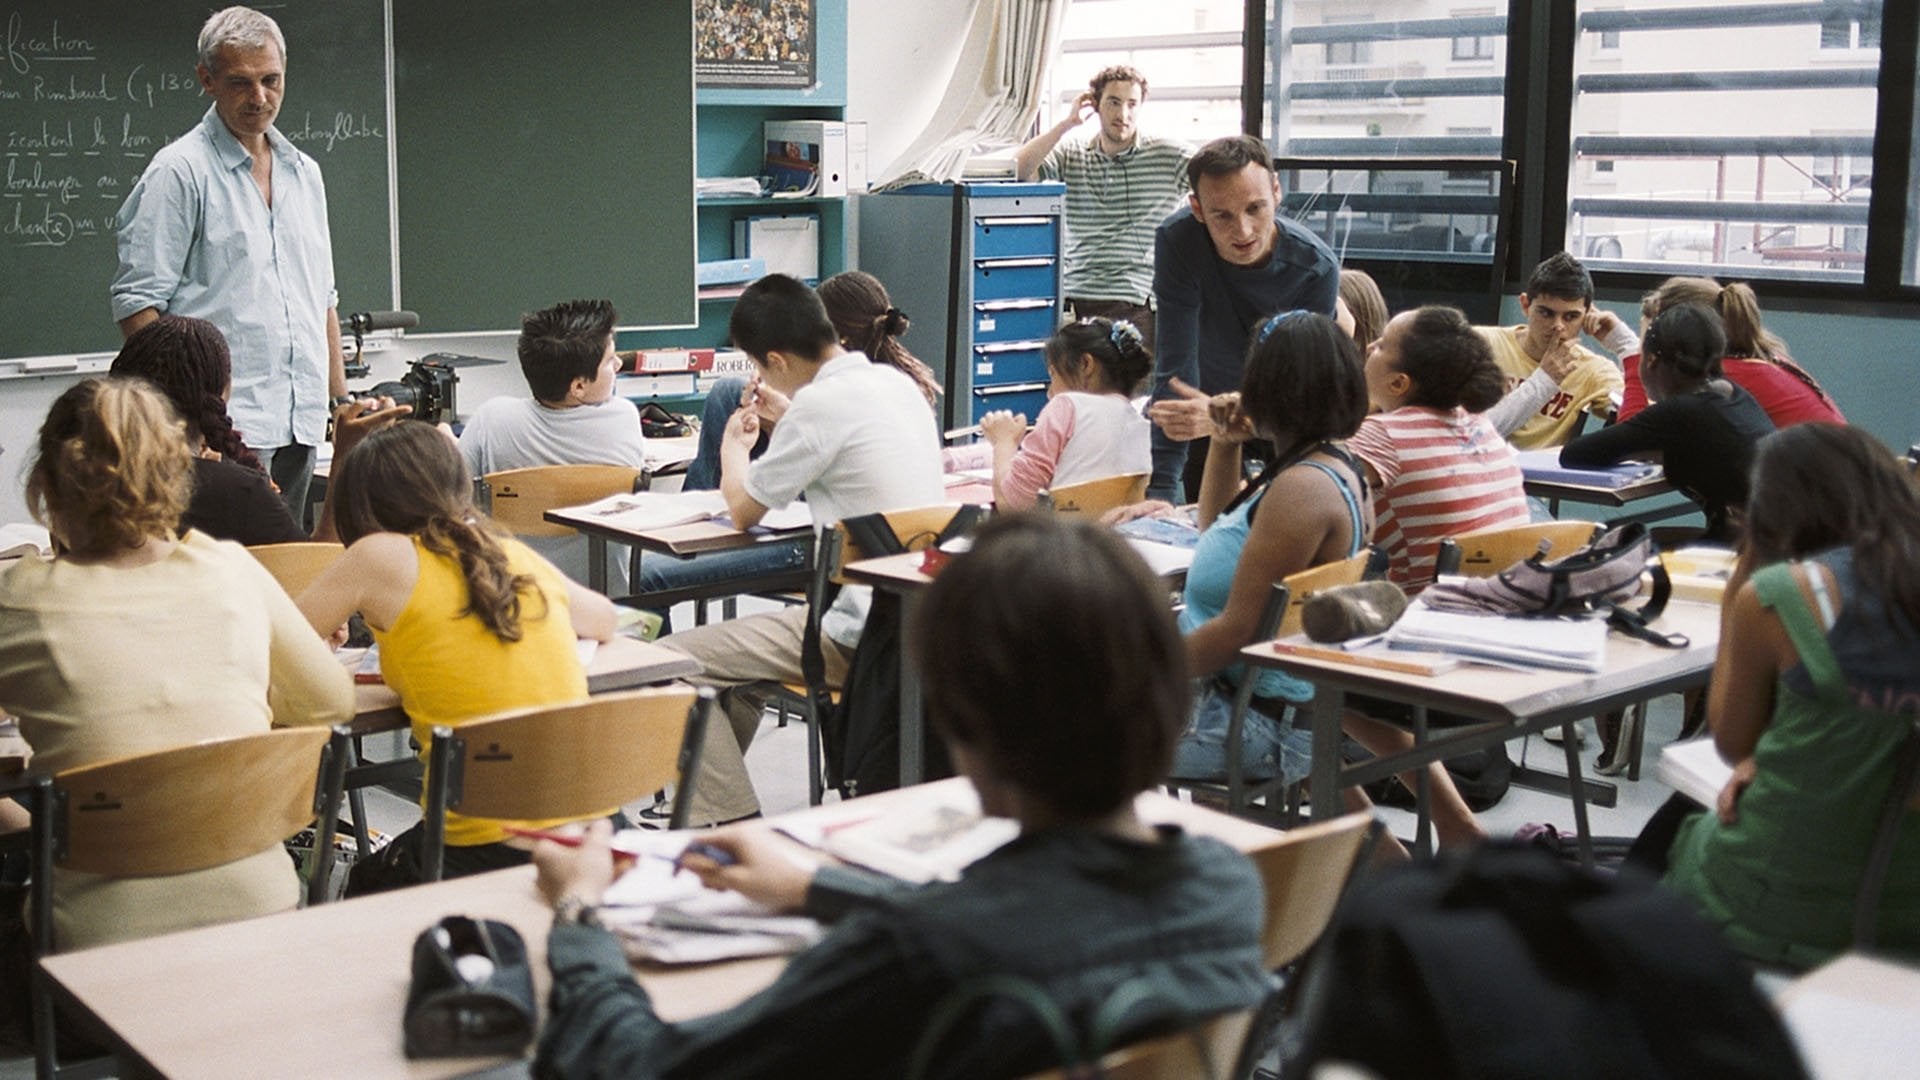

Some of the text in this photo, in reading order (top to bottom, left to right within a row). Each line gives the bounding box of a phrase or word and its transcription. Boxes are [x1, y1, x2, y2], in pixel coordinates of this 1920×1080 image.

[0, 12, 95, 74] fication
[121, 111, 152, 148] bon
[5, 158, 83, 204] boulanger
